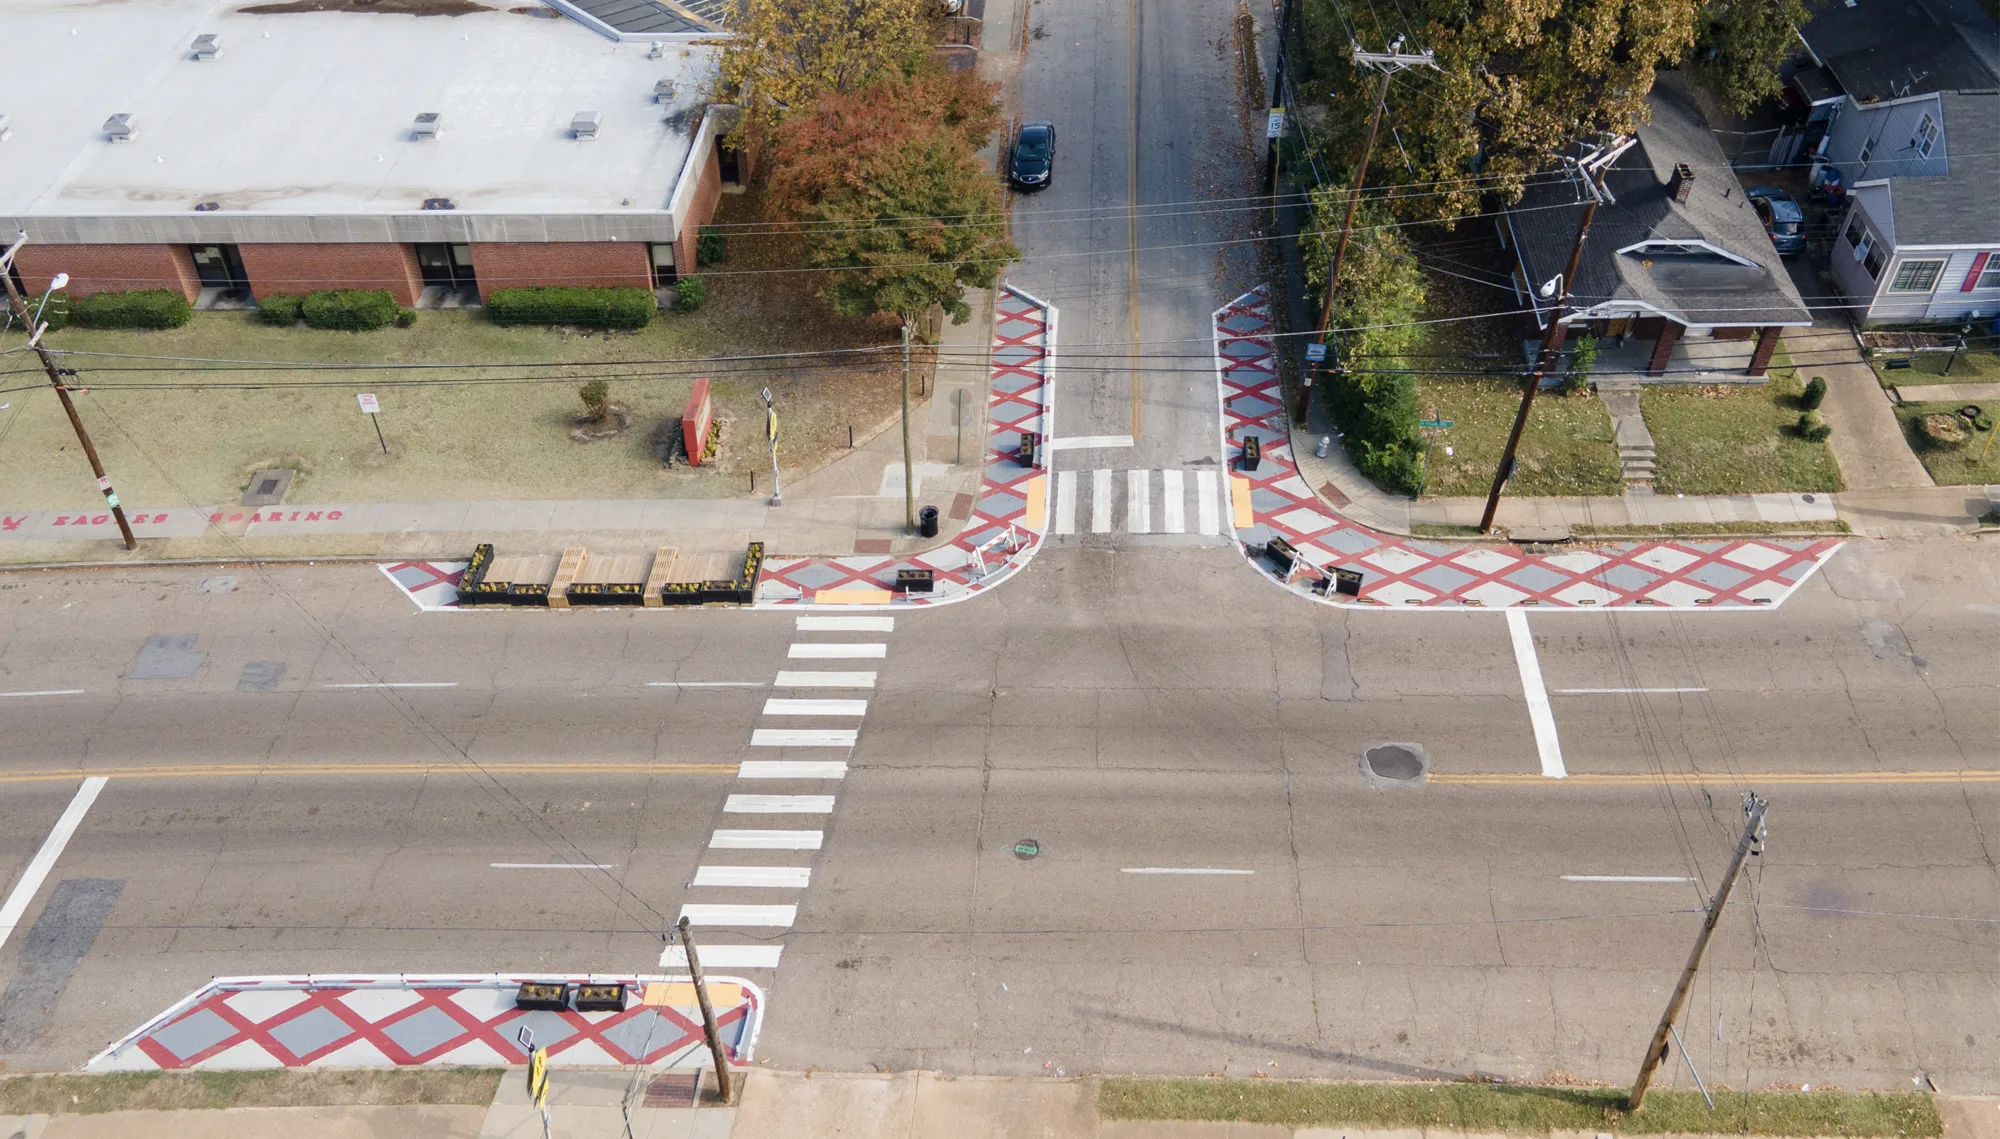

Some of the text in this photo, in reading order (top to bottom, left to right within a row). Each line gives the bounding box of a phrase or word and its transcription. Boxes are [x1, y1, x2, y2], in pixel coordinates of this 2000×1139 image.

[1270, 122, 1280, 130] 15
[52, 511, 343, 526] EAGES SOARING
